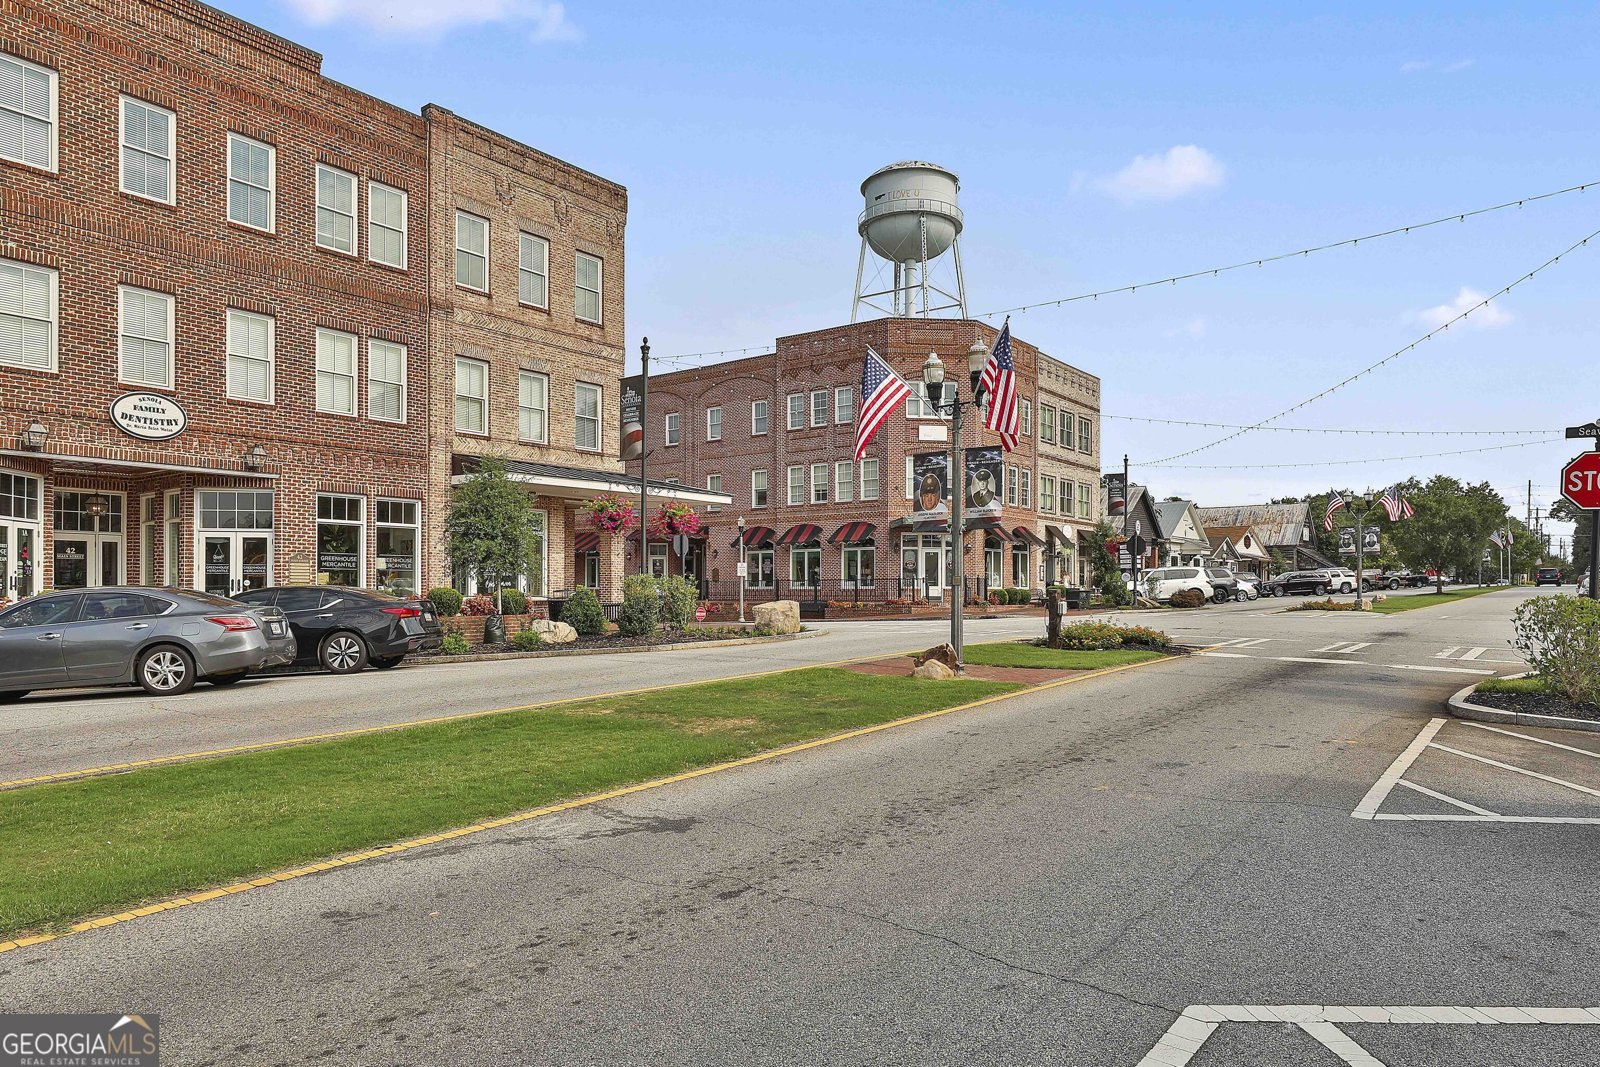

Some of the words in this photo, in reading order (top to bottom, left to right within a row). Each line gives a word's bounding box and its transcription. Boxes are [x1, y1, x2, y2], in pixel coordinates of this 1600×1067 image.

[893, 190, 910, 199] LOVE
[914, 189, 919, 197] U
[138, 396, 162, 405] SENOIA
[621, 394, 642, 405] Senoia
[133, 404, 167, 414] FAMILY
[120, 412, 179, 426] DENTISTRY
[1568, 470, 1600, 492] ST
